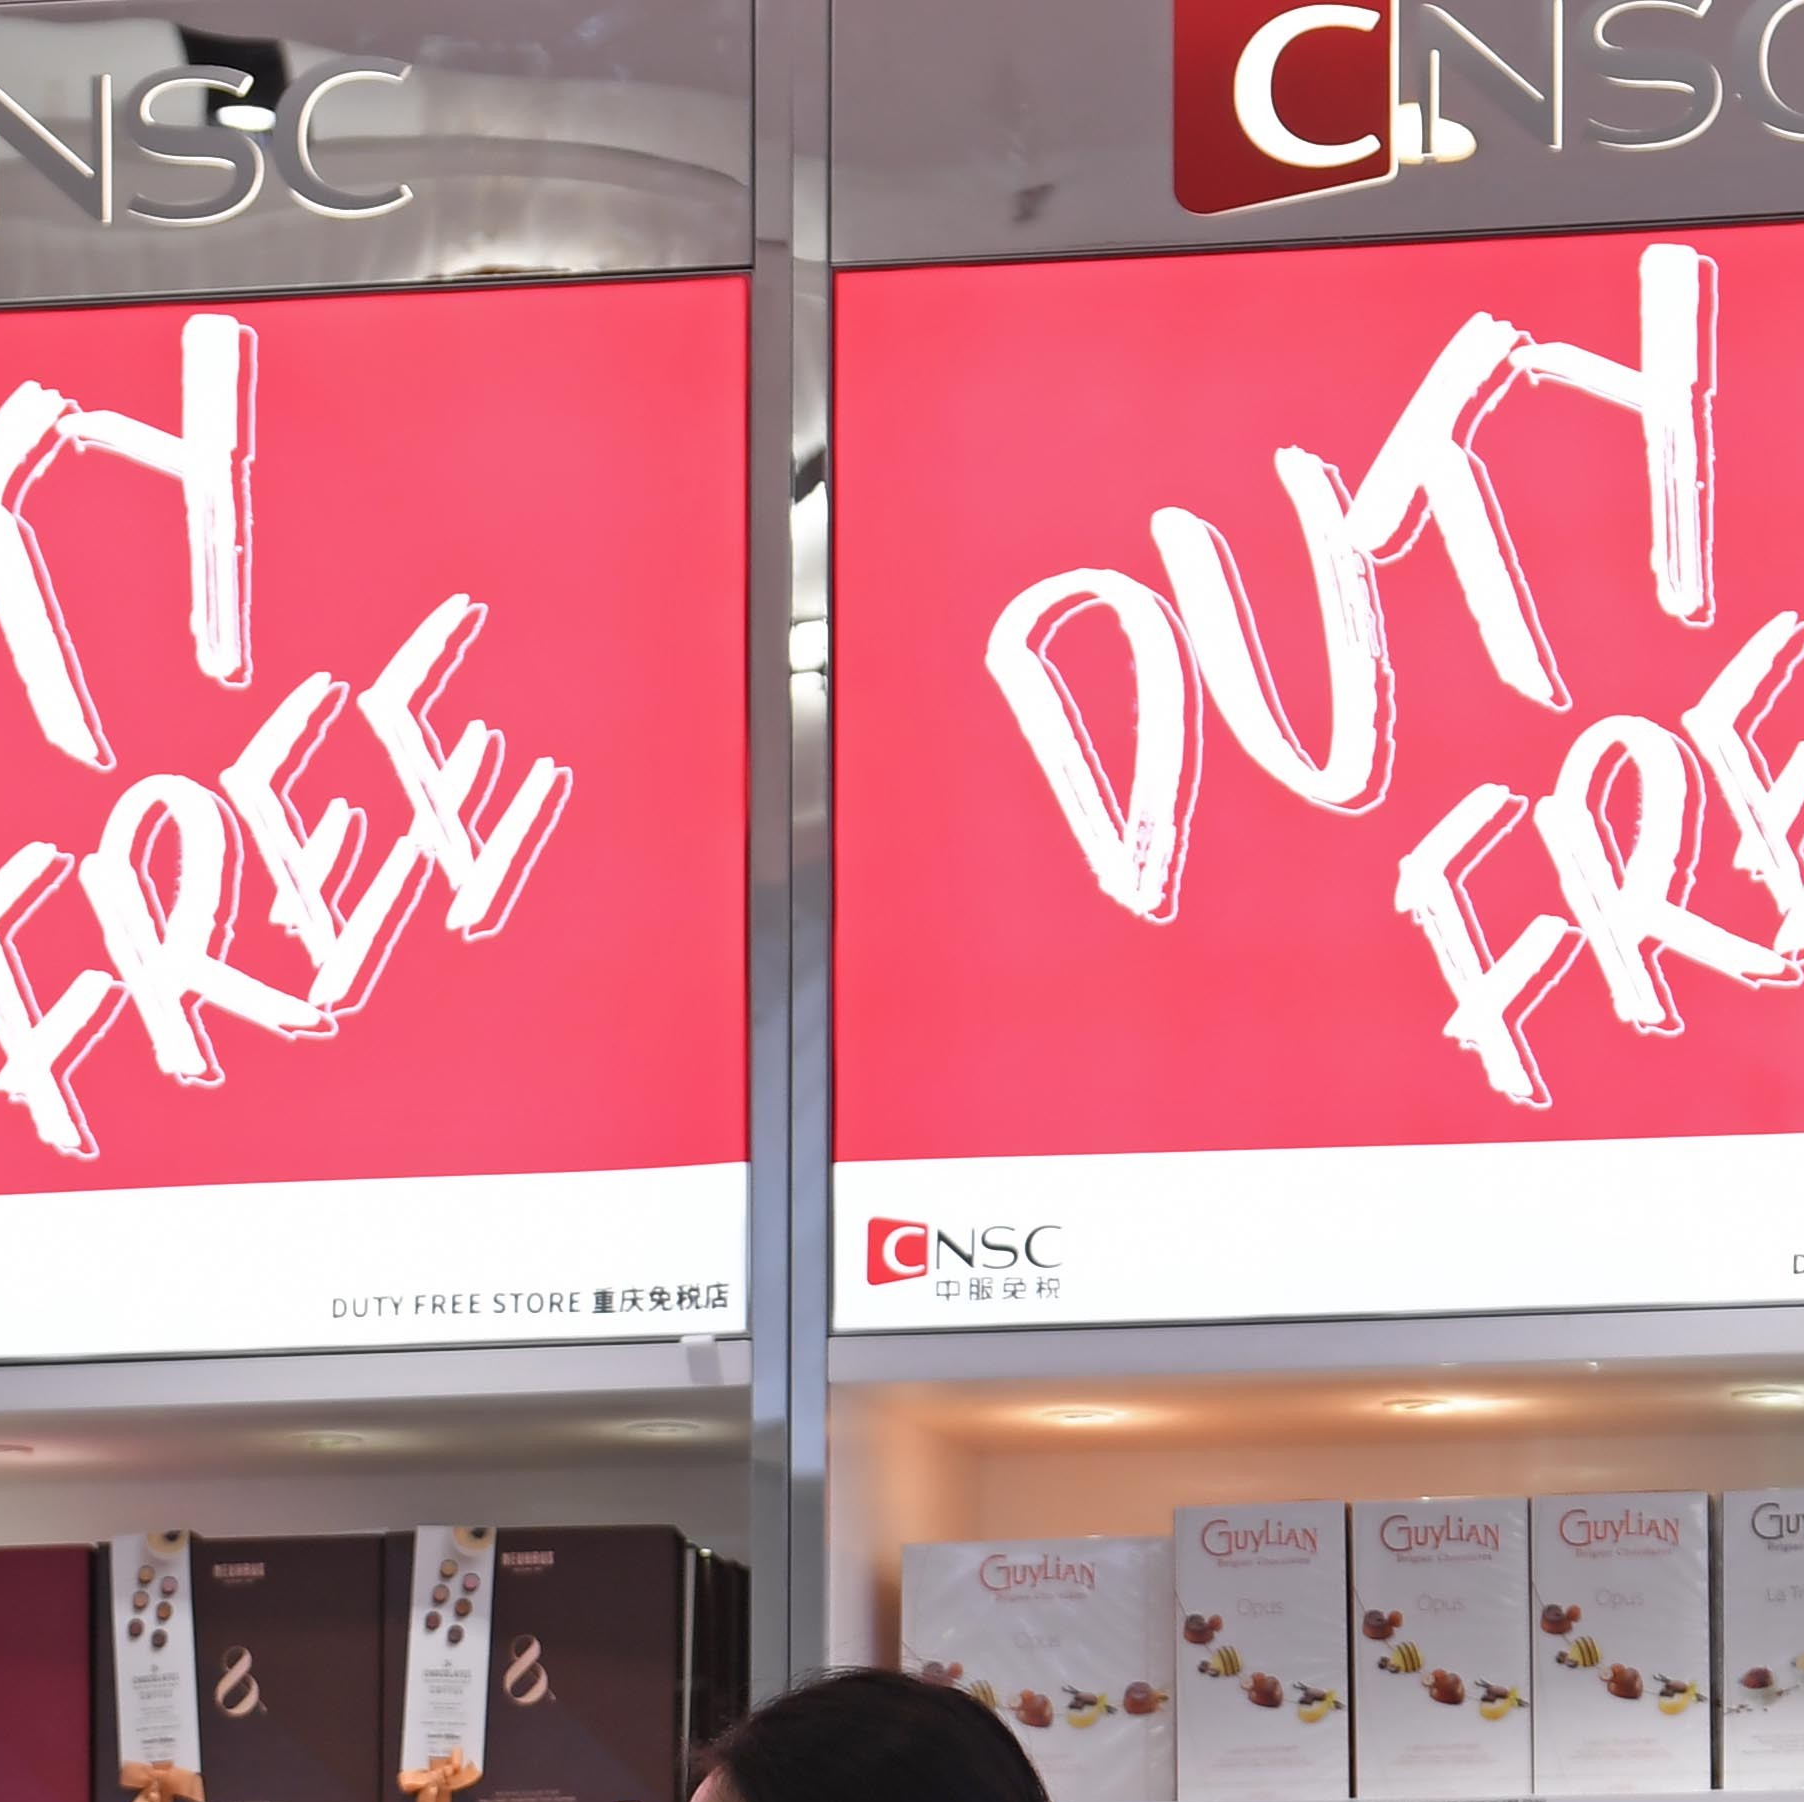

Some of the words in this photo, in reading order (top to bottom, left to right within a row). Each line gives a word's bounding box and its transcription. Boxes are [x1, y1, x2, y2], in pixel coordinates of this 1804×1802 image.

[984, 242, 1718, 924] DUTY
[882, 1225, 1062, 1275] CNSC
[332, 1296, 403, 1318] DUTY
[414, 1293, 481, 1315] FREE
[493, 1291, 581, 1313] STORE
[591, 1282, 729, 1313] 重庆免税店
[936, 1276, 1061, 1302] 中服免税
[1416, 1594, 1465, 1613] Opus
[1595, 1589, 1645, 1608] Opus
[1766, 1587, 1786, 1601] La
